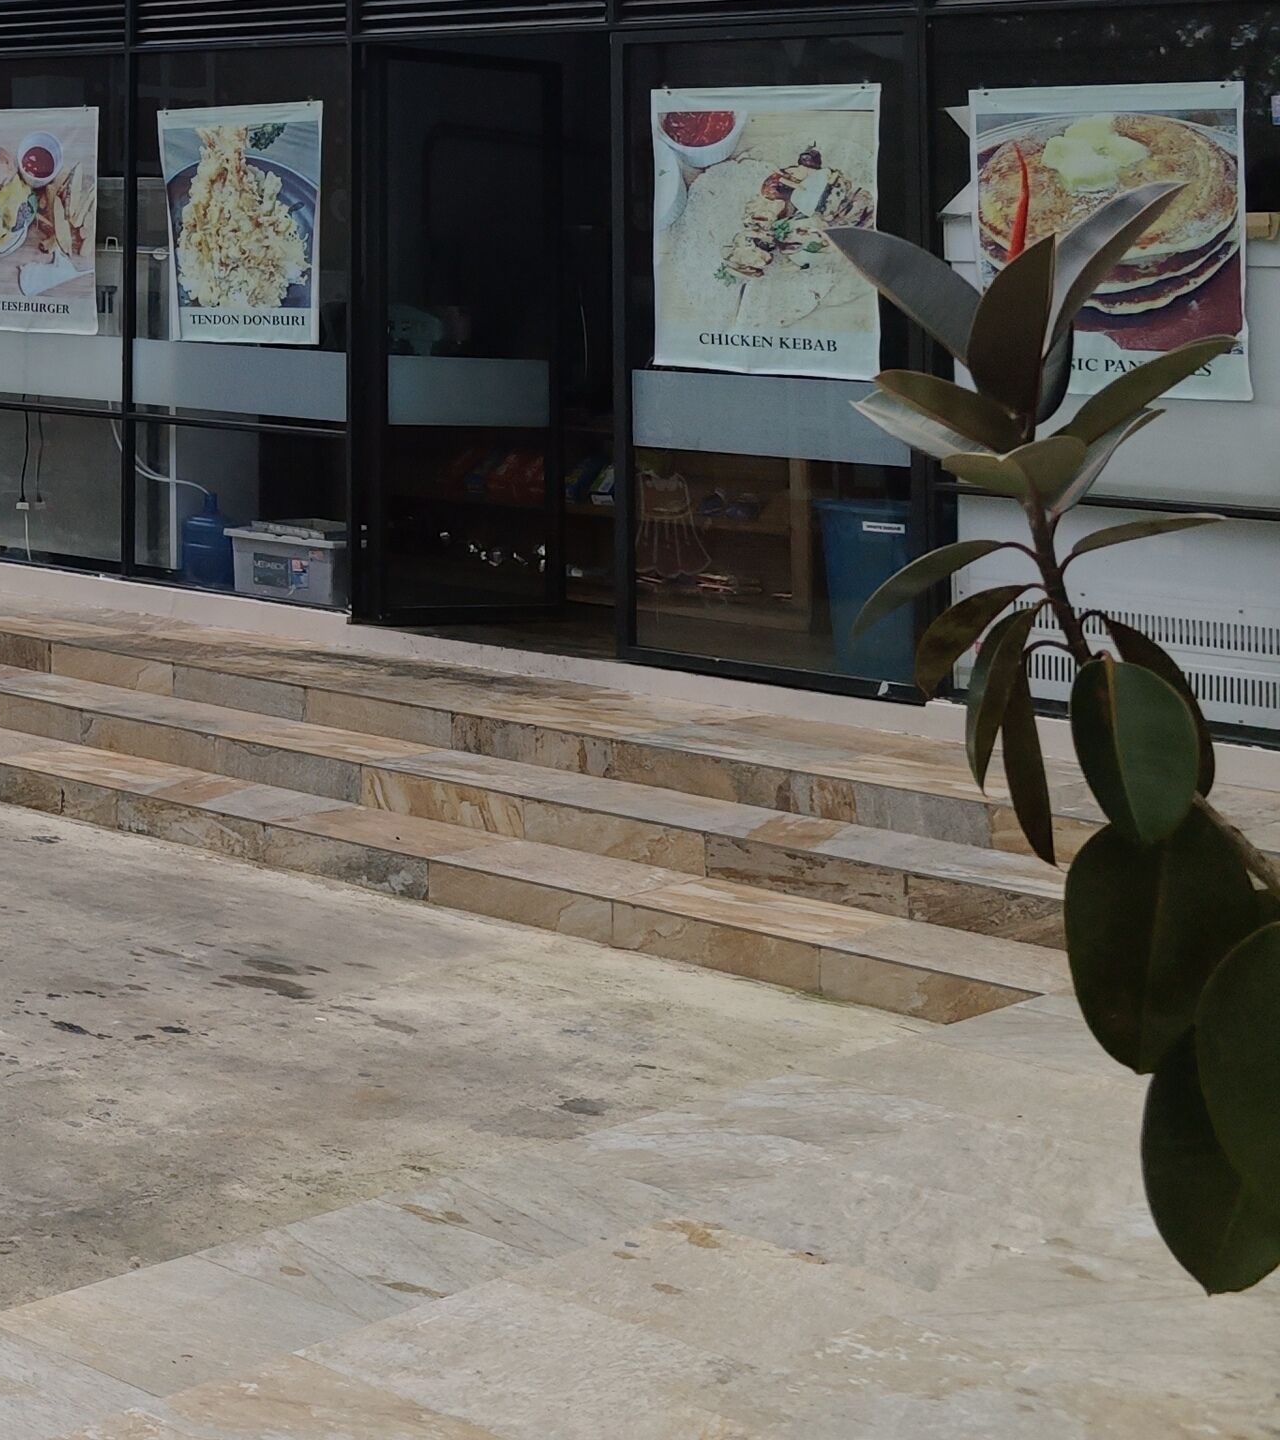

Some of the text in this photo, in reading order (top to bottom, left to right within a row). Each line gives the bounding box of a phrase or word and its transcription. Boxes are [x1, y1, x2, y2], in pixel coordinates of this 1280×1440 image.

[190, 314, 306, 326] TENDON DONBURI
[699, 332, 838, 353] CHICKEN KEBAB
